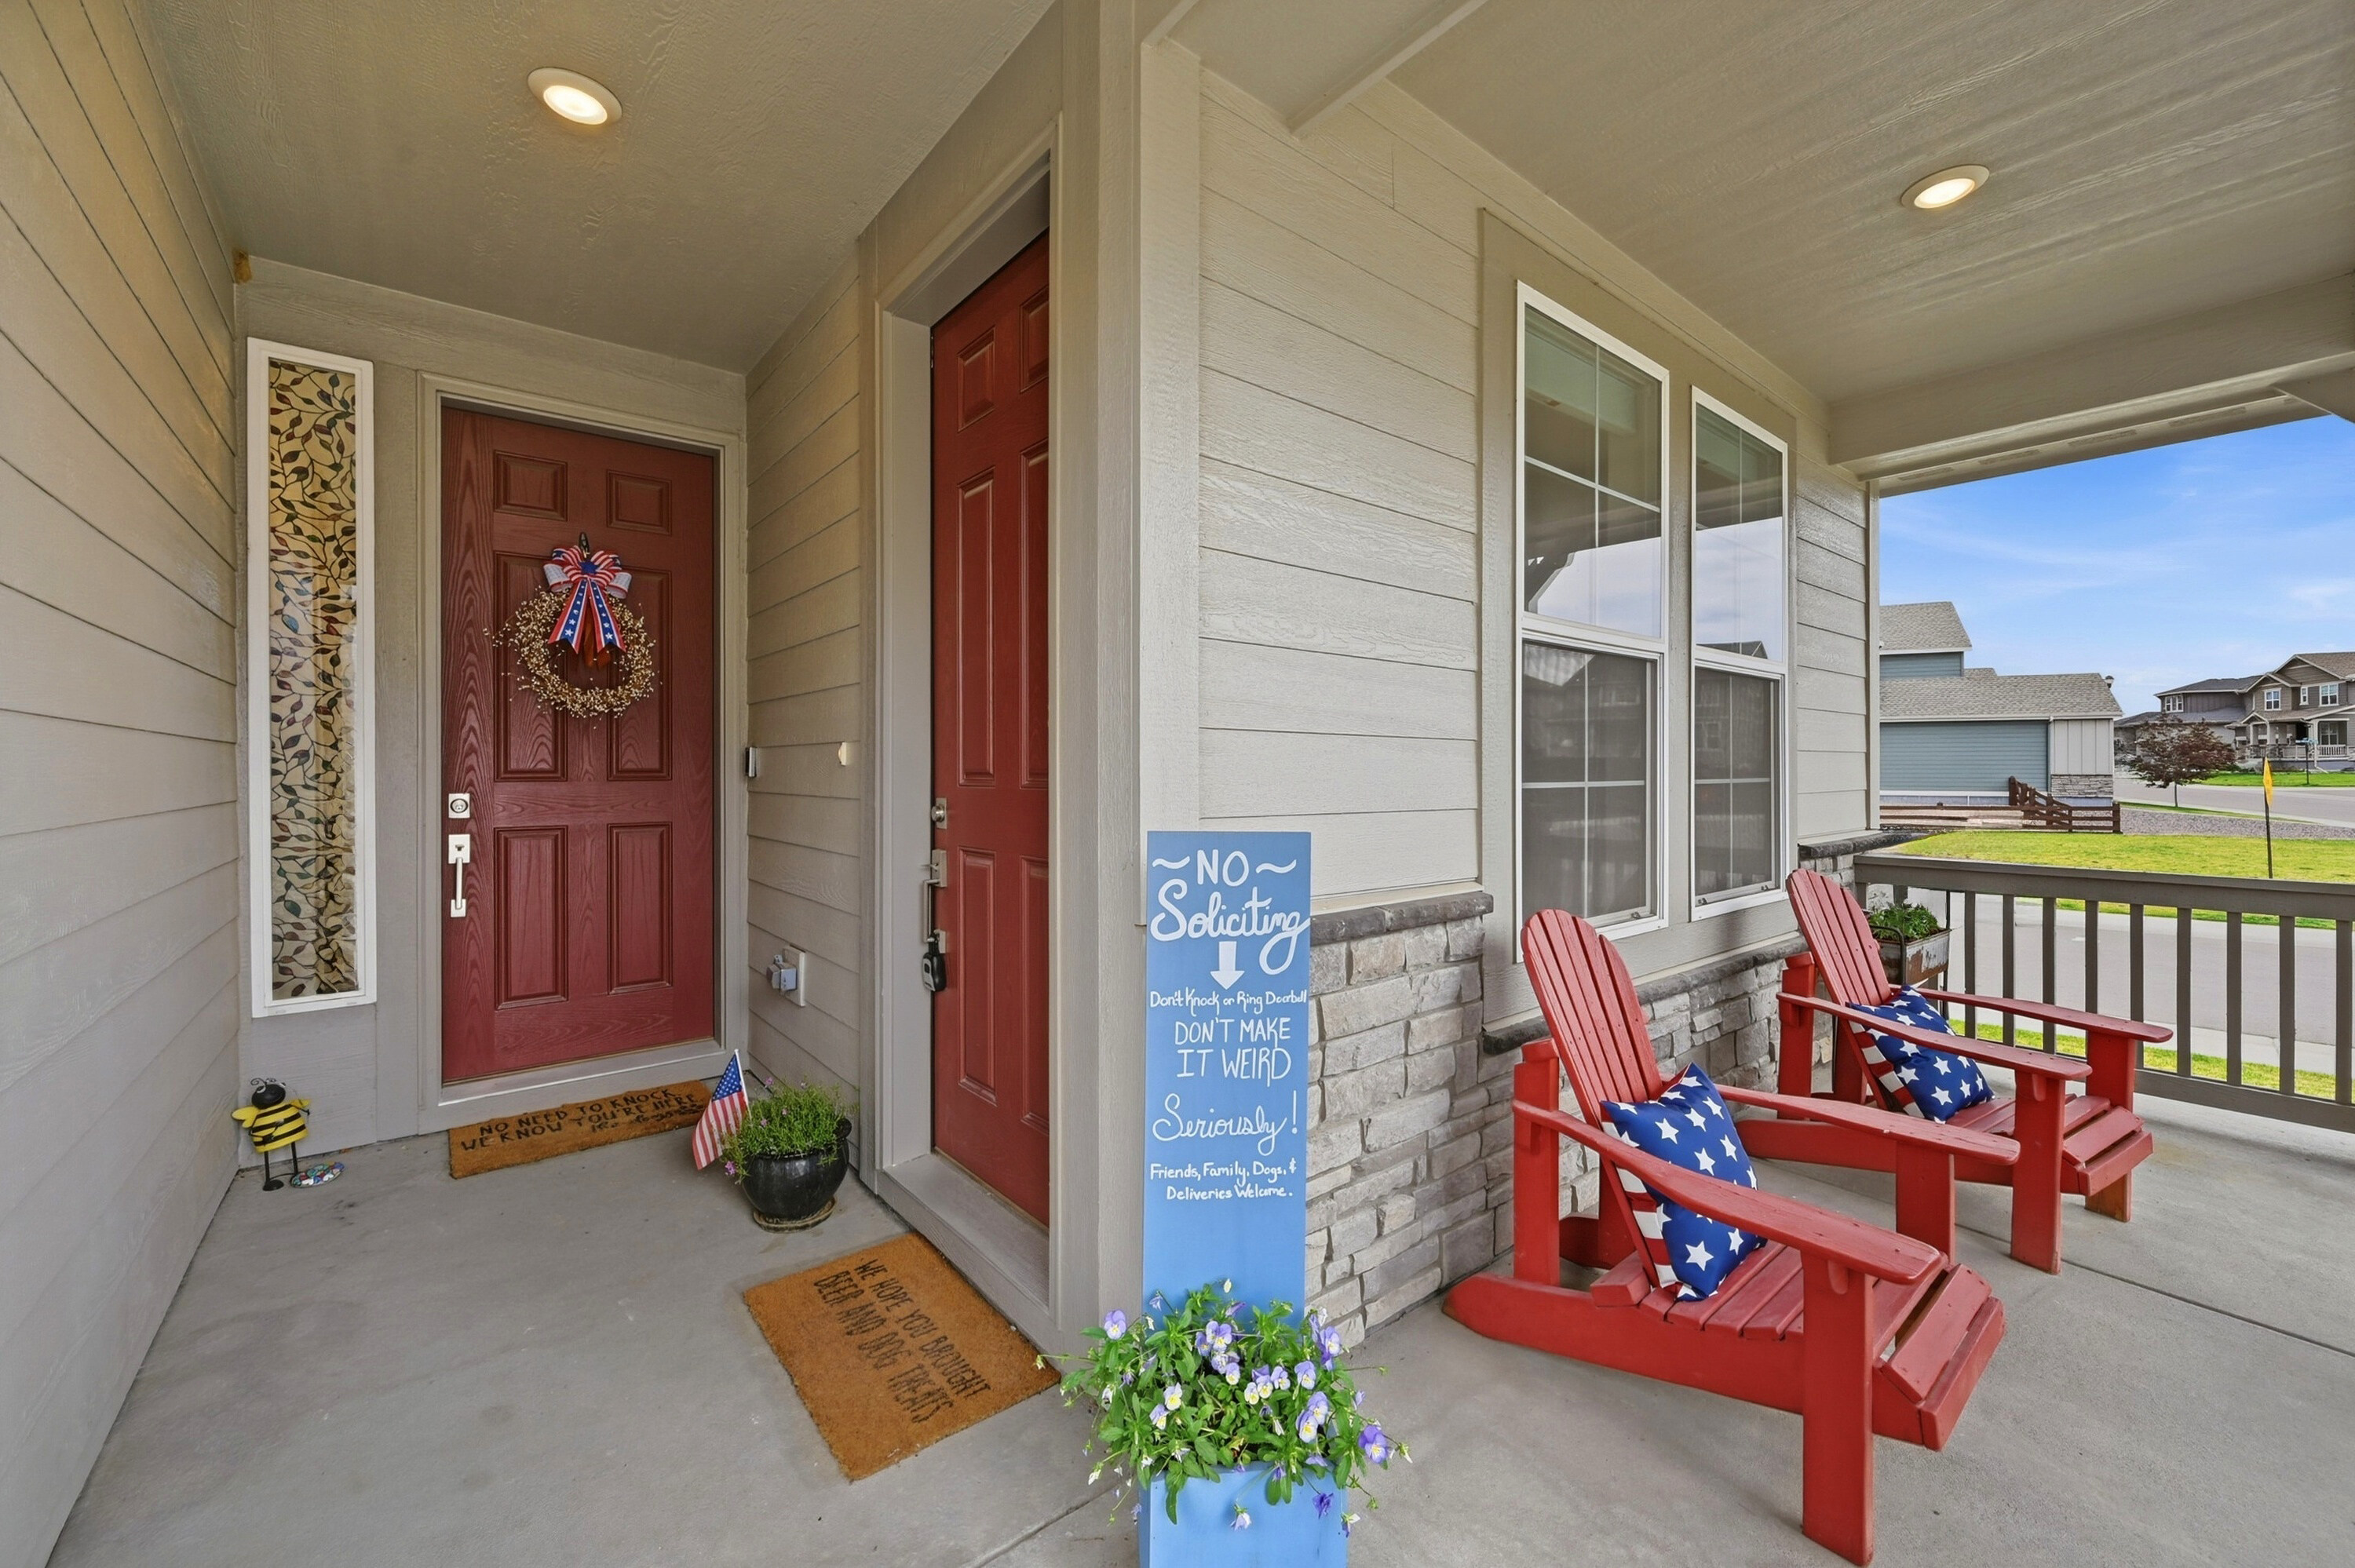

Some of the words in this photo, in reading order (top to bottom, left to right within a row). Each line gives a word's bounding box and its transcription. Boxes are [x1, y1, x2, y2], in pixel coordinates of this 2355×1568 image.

[1197, 849, 1250, 887] NO
[1150, 878, 1311, 975] Soliciting
[1150, 990, 1184, 1008] Don't
[1185, 986, 1220, 1017] Knock
[1237, 990, 1263, 1015] Ring
[1265, 989, 1307, 1004] Doorbell
[1175, 1017, 1235, 1045] DON'T
[1240, 1017, 1291, 1048] MAKE
[1177, 1048, 1214, 1078] IT
[1221, 1047, 1292, 1088] WEIRD
[461, 1136, 491, 1150] WE
[500, 1121, 562, 1143] KNOW
[569, 1105, 646, 1127] YOU'RE
[480, 1122, 509, 1136] NO
[518, 1110, 568, 1128] NEED
[576, 1103, 602, 1115] TO
[1150, 1163, 1201, 1181] Friends,
[1203, 1161, 1250, 1187] Family,
[1253, 1161, 1287, 1183] Dogs,
[1167, 1186, 1232, 1200] Deliveries
[1233, 1183, 1293, 1199] Welcome.
[854, 1258, 888, 1281] WE
[813, 1270, 865, 1308] BEER
[869, 1277, 915, 1313] HOPE
[836, 1301, 887, 1336] AND
[895, 1308, 939, 1339] YOU
[858, 1332, 911, 1370] DOG
[918, 1335, 991, 1399] BROUGHT
[887, 1364, 954, 1424] TREATS
